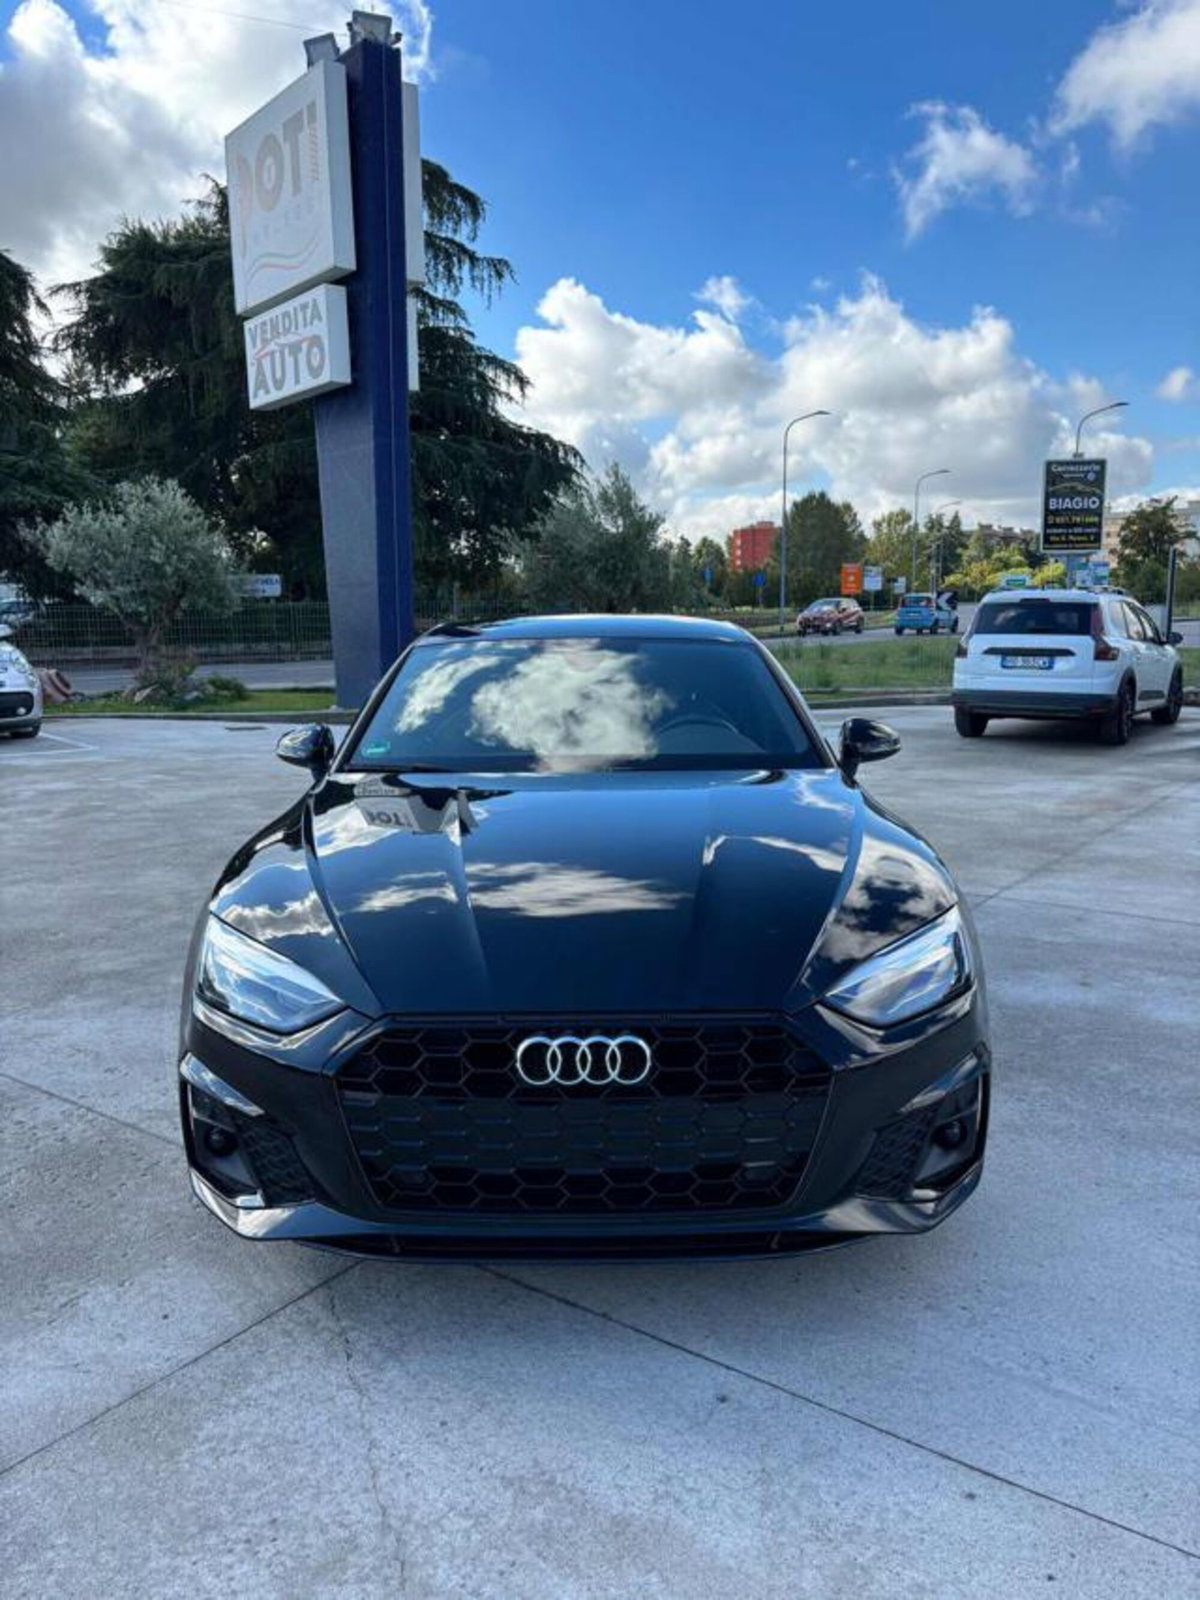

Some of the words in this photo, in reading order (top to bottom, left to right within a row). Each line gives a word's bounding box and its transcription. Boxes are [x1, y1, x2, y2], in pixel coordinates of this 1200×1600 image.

[248, 299, 323, 350] VENDITA
[252, 334, 326, 400] AUTO
[1049, 497, 1100, 510] BIAGIO
